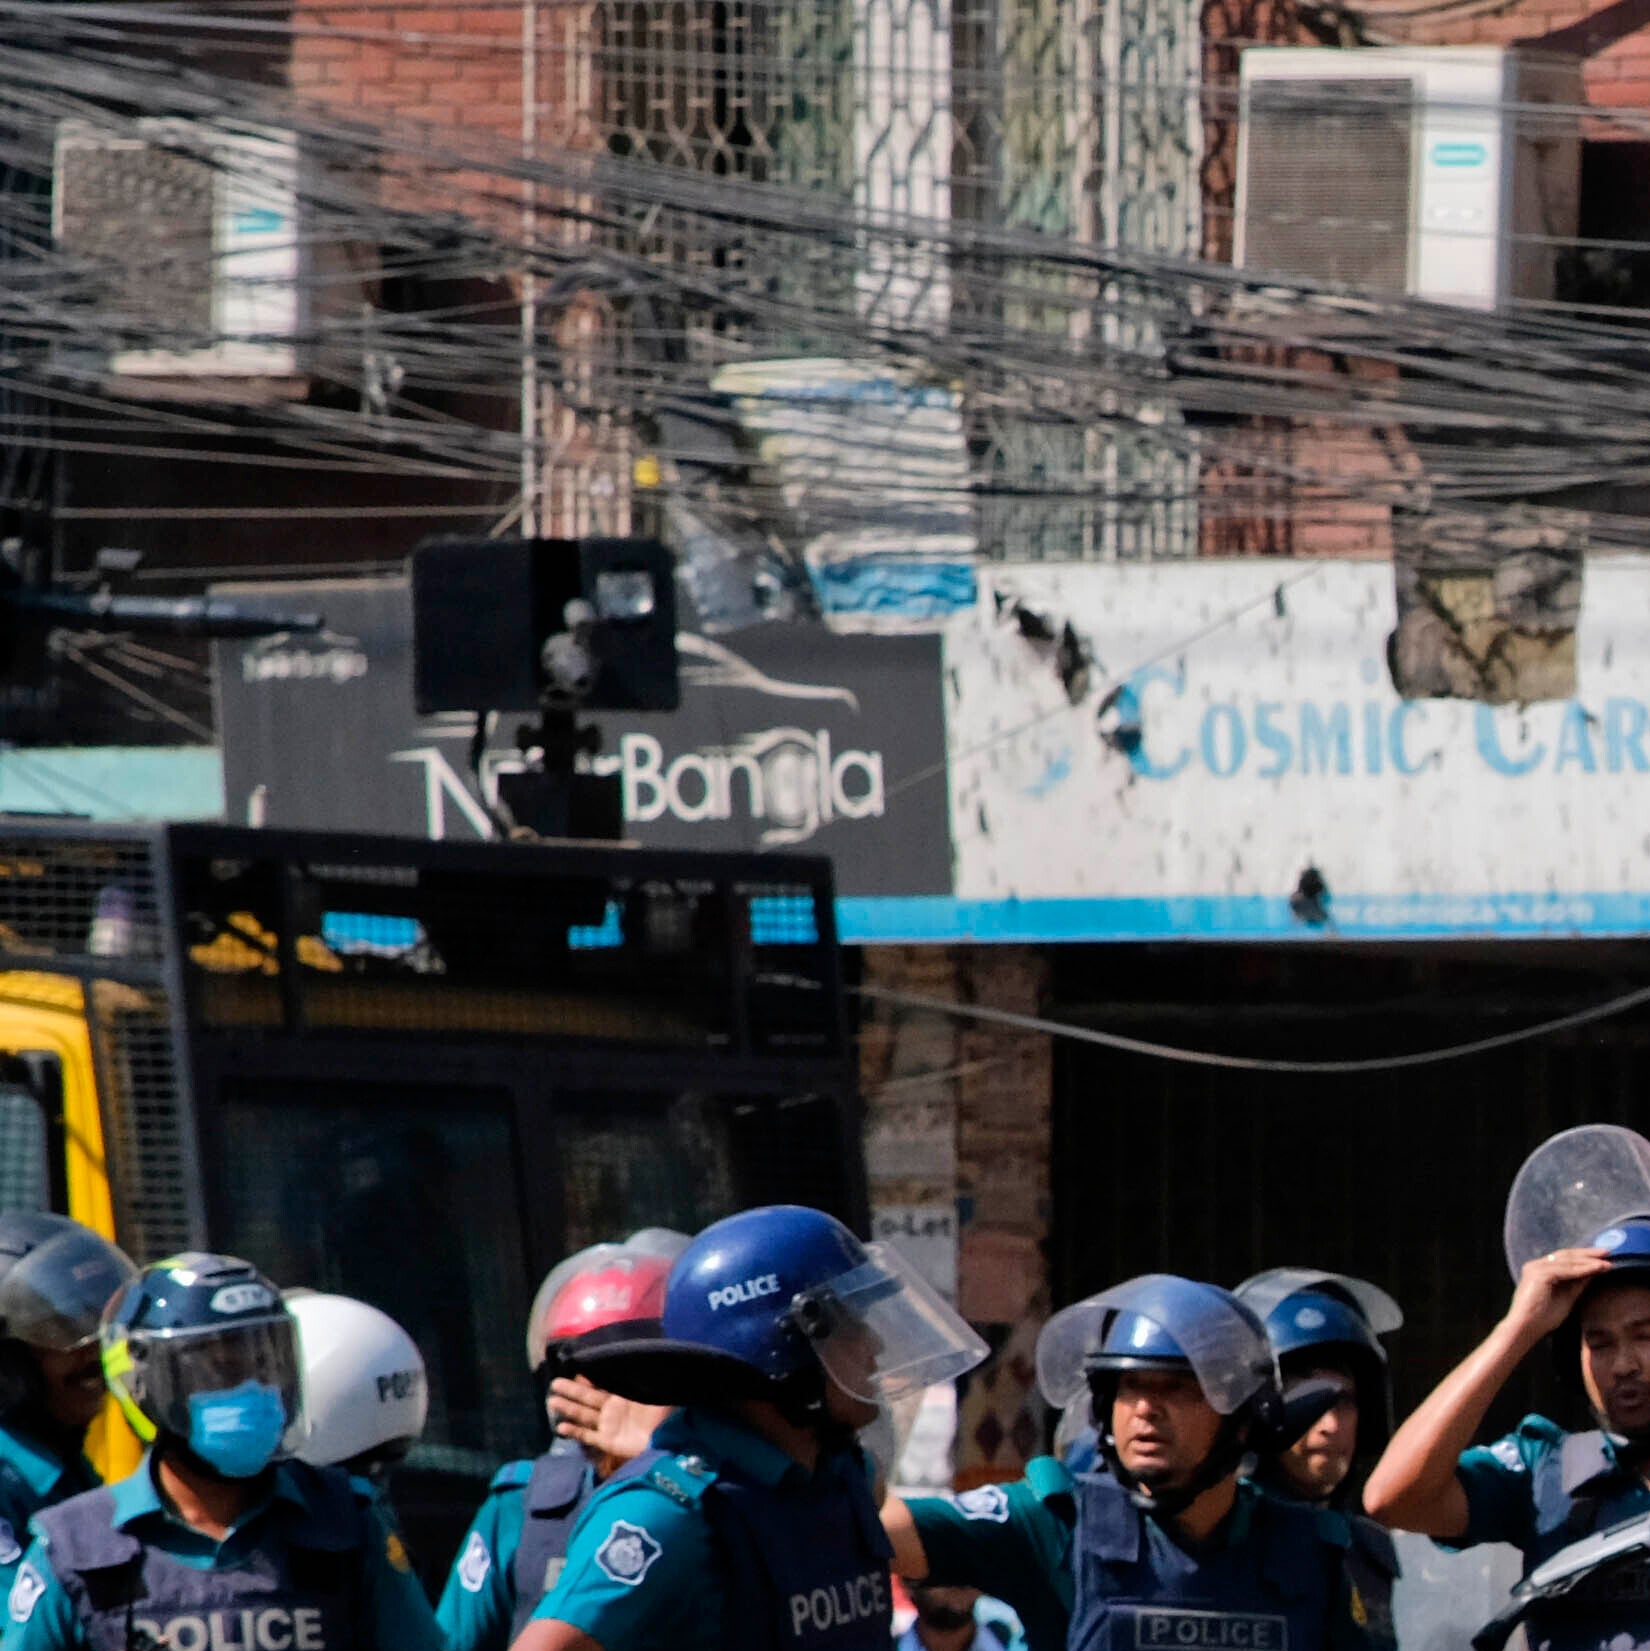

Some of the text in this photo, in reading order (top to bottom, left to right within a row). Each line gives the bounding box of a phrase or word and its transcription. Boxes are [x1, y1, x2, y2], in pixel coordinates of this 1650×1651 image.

[707, 1273, 781, 1311] POLICE
[788, 1571, 888, 1637] POLICE
[1149, 1617, 1272, 1650] POLICE
